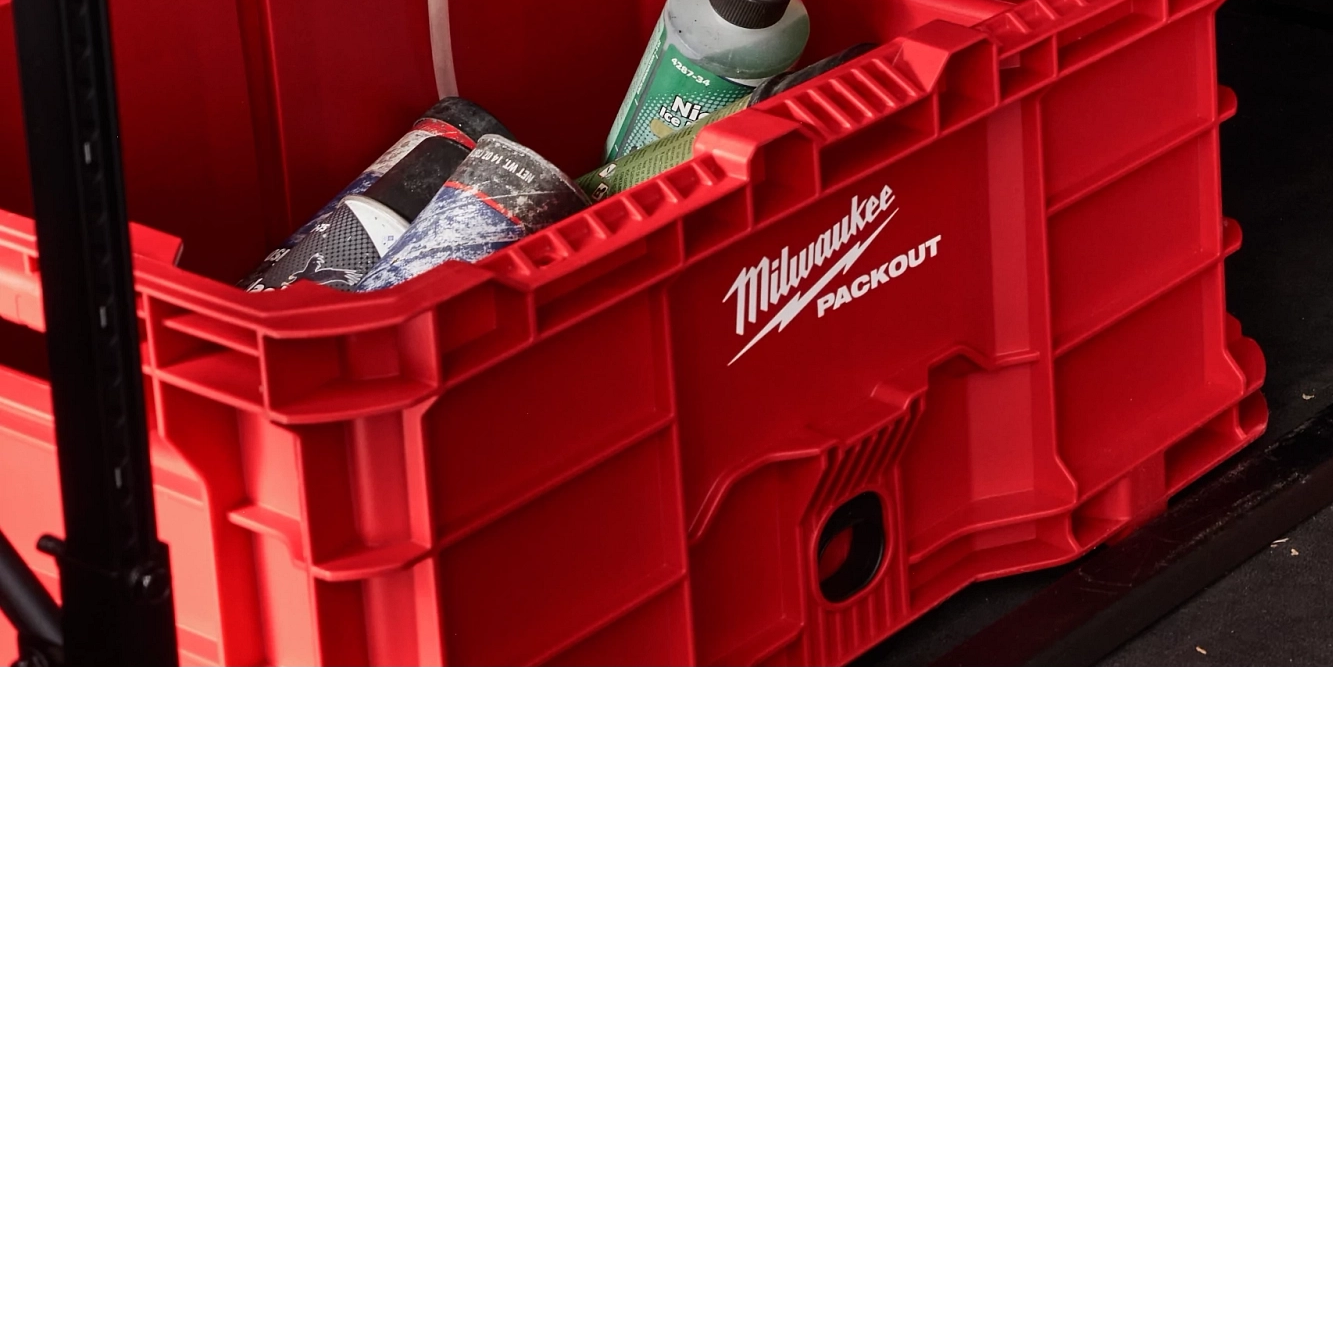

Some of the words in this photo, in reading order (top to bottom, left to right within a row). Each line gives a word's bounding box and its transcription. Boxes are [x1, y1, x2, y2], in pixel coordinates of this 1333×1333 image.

[671, 57, 710, 87] 4287-34
[659, 106, 681, 128] Ice
[492, 153, 503, 165] 14
[502, 158, 519, 175] WT.
[515, 167, 536, 184] NET
[722, 184, 896, 336] Milwaukee
[817, 234, 942, 318] PACKOUT
